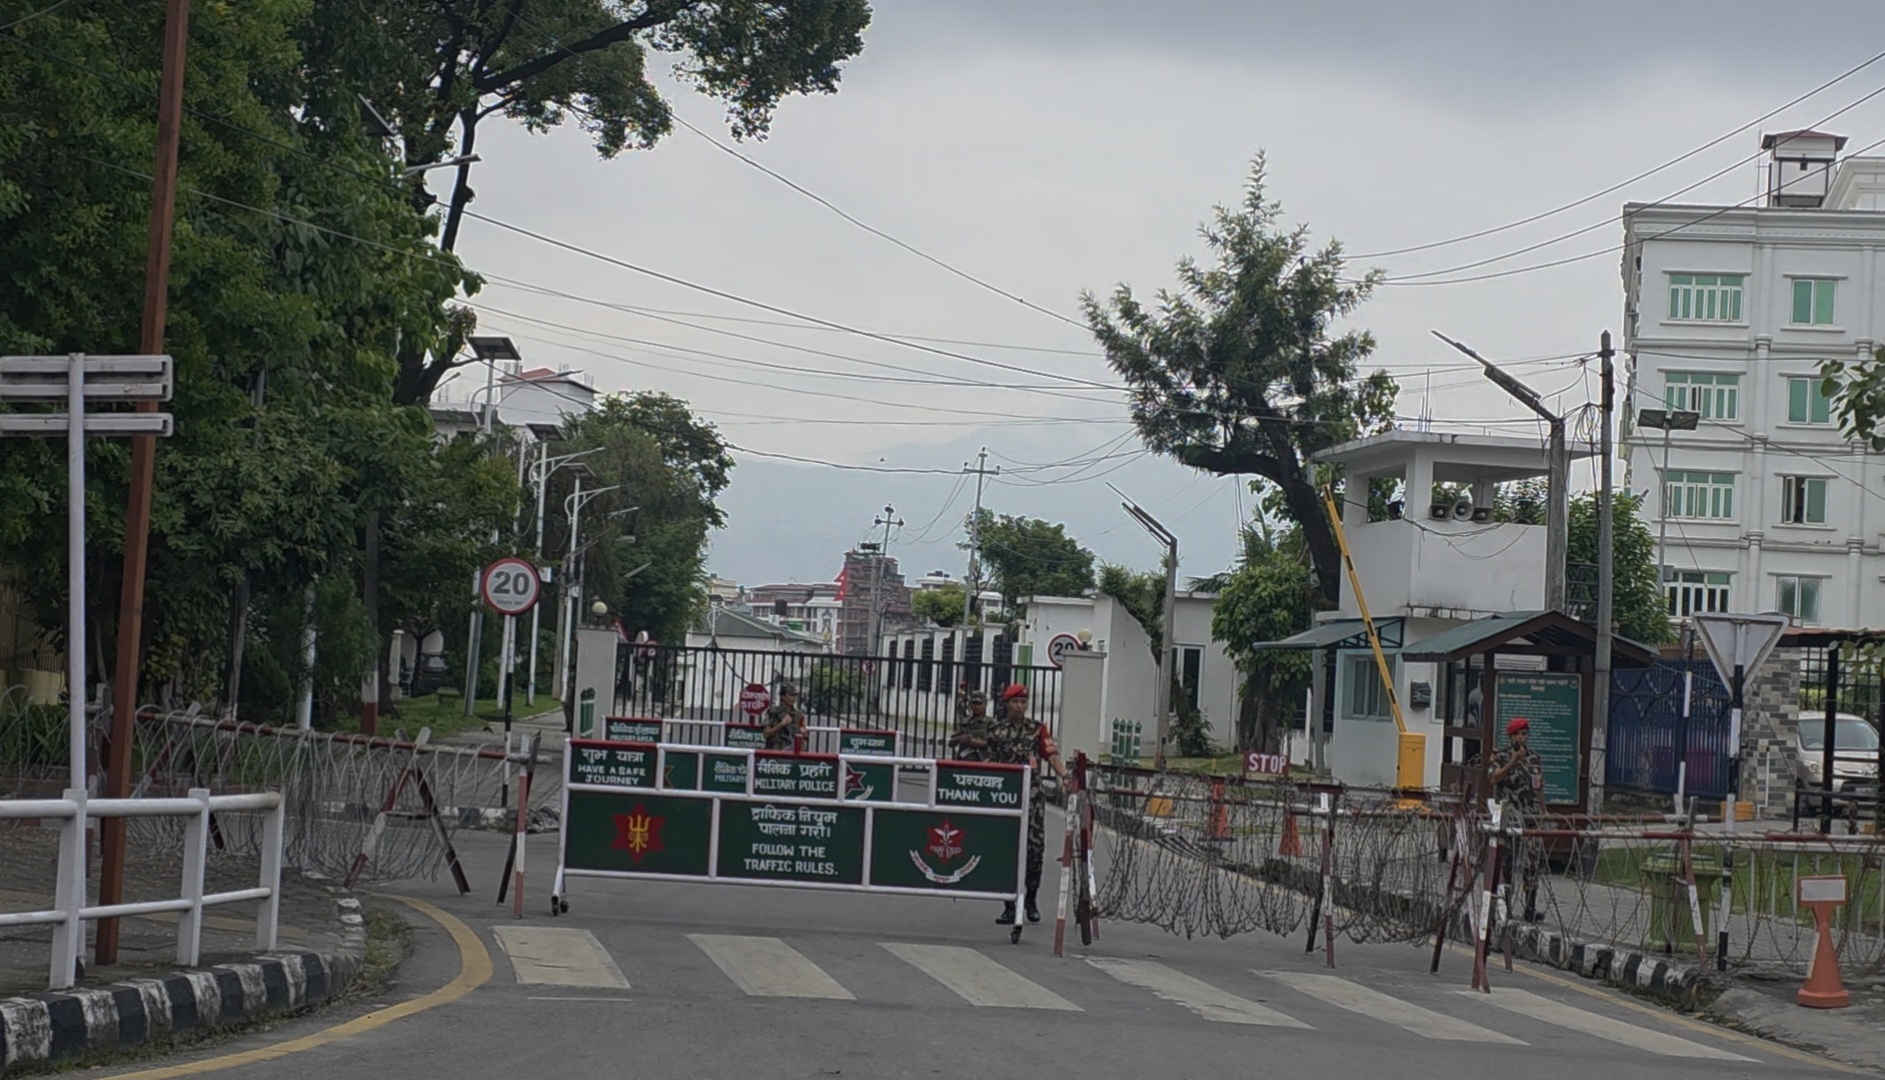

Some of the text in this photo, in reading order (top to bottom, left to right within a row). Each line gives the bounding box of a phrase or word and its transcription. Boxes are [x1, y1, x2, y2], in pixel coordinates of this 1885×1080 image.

[493, 571, 530, 596] 20
[740, 701, 765, 710] STOP
[610, 734, 636, 742] MILITARY
[581, 749, 645, 764] शुभ यात्रा
[1248, 753, 1287, 774] STOP
[578, 764, 646, 776] HAVE A SAFE
[757, 759, 791, 775] सैनिक
[799, 762, 833, 778] प्रहरी
[585, 774, 640, 785] JOURNEY
[755, 778, 835, 792] MILITARY POLICE
[953, 773, 1004, 789] धन्यवाद
[938, 788, 1018, 804] THANK YOU
[751, 804, 796, 821] ट्राफिक
[758, 823, 797, 836] पालना
[752, 843, 826, 858] FOLLOW THE
[744, 858, 838, 875] TRAFFIC RULES.
